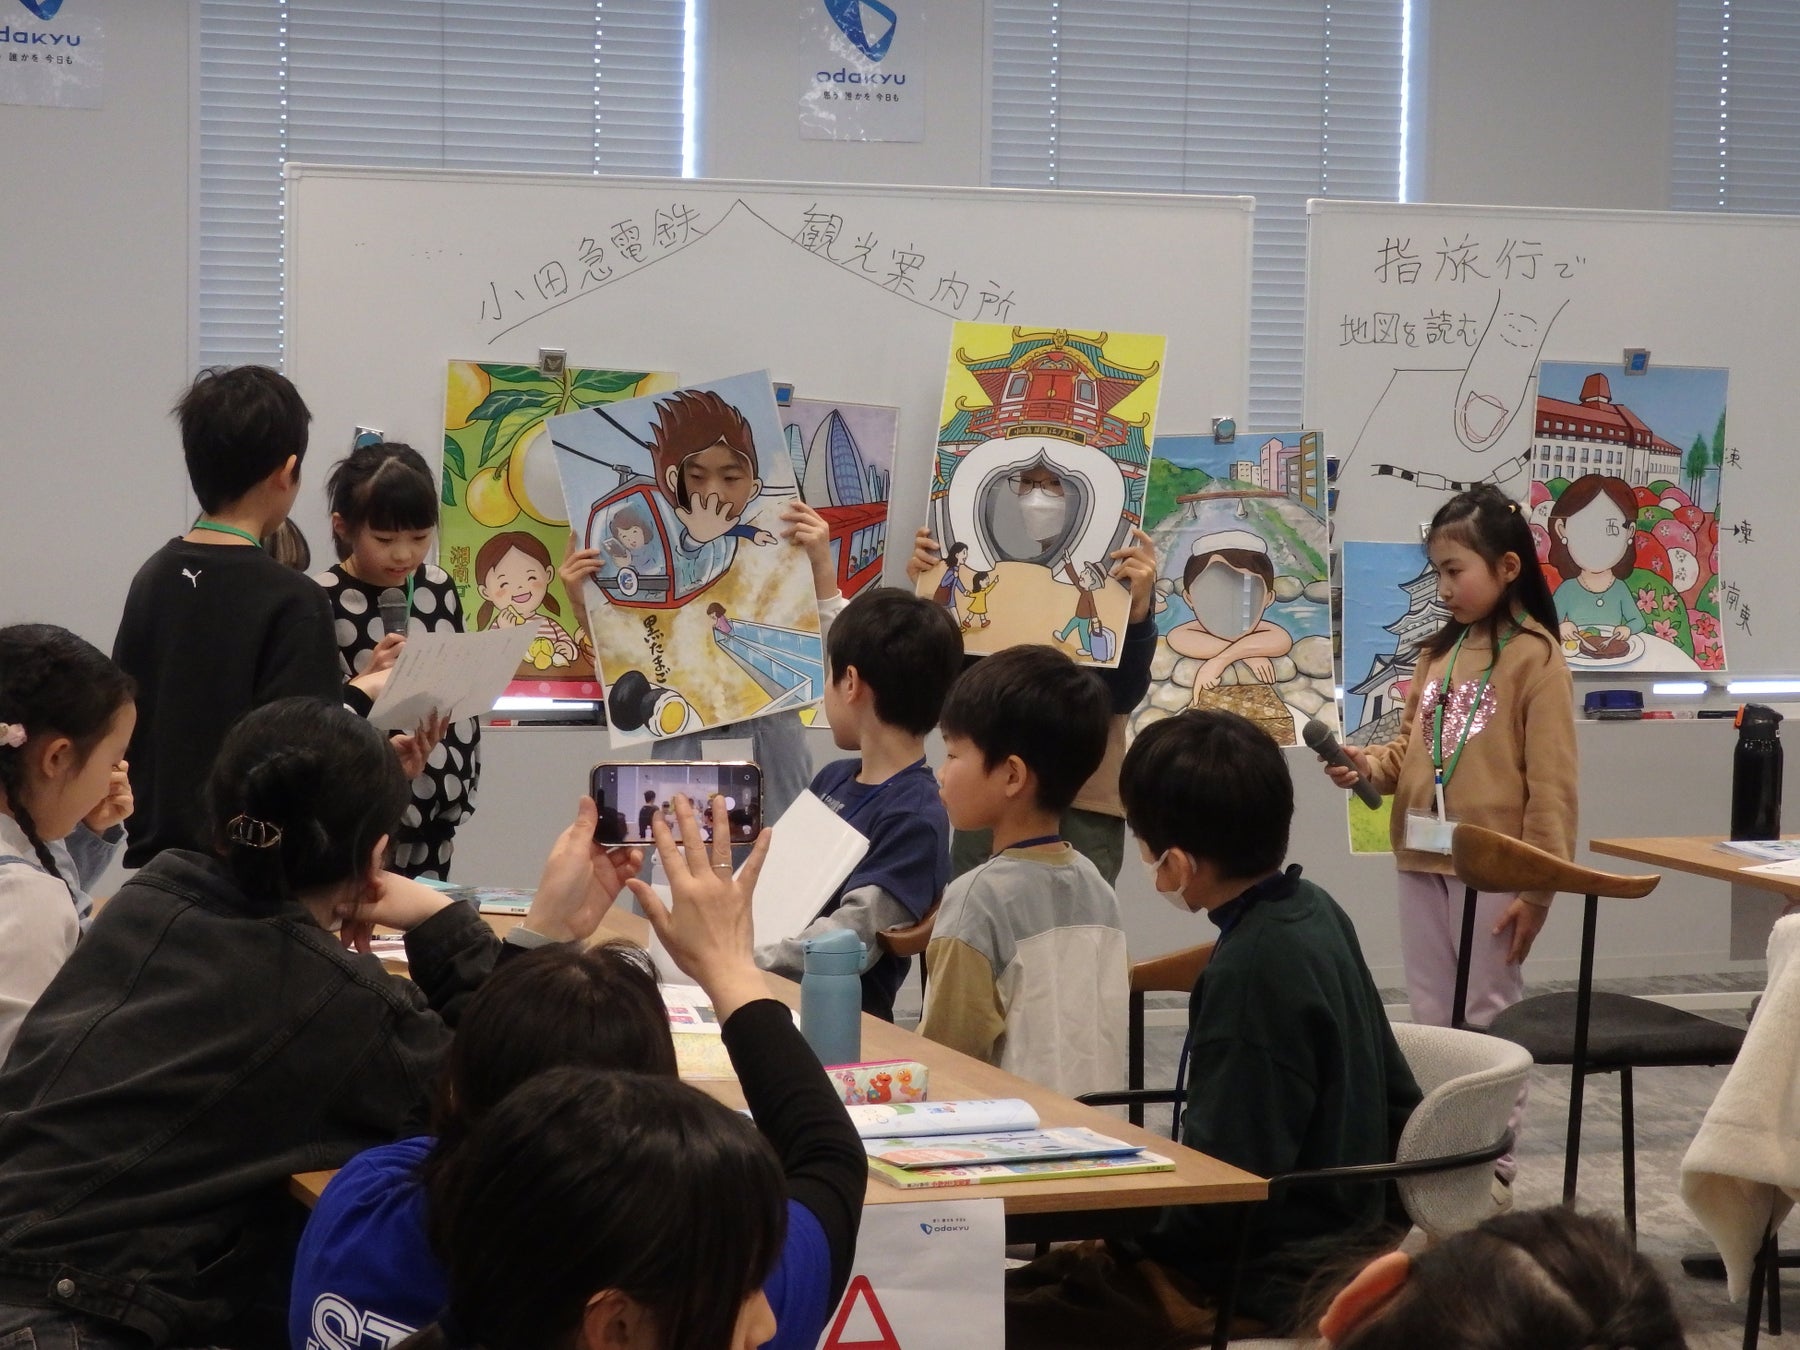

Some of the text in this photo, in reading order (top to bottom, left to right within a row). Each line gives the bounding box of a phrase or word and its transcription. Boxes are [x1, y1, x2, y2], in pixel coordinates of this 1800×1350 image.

[45, 54, 73, 65] 今日も
[816, 67, 906, 85] odakyu
[876, 93, 899, 102] 今日も
[481, 202, 1017, 324] 小田急電鉄 観光案内所
[1374, 233, 1587, 285] 指旅行で
[1339, 308, 1478, 348] 地図を読む
[1605, 517, 1620, 537] 西
[643, 614, 671, 684] 黒たまご
[934, 1224, 970, 1232] odakyu
